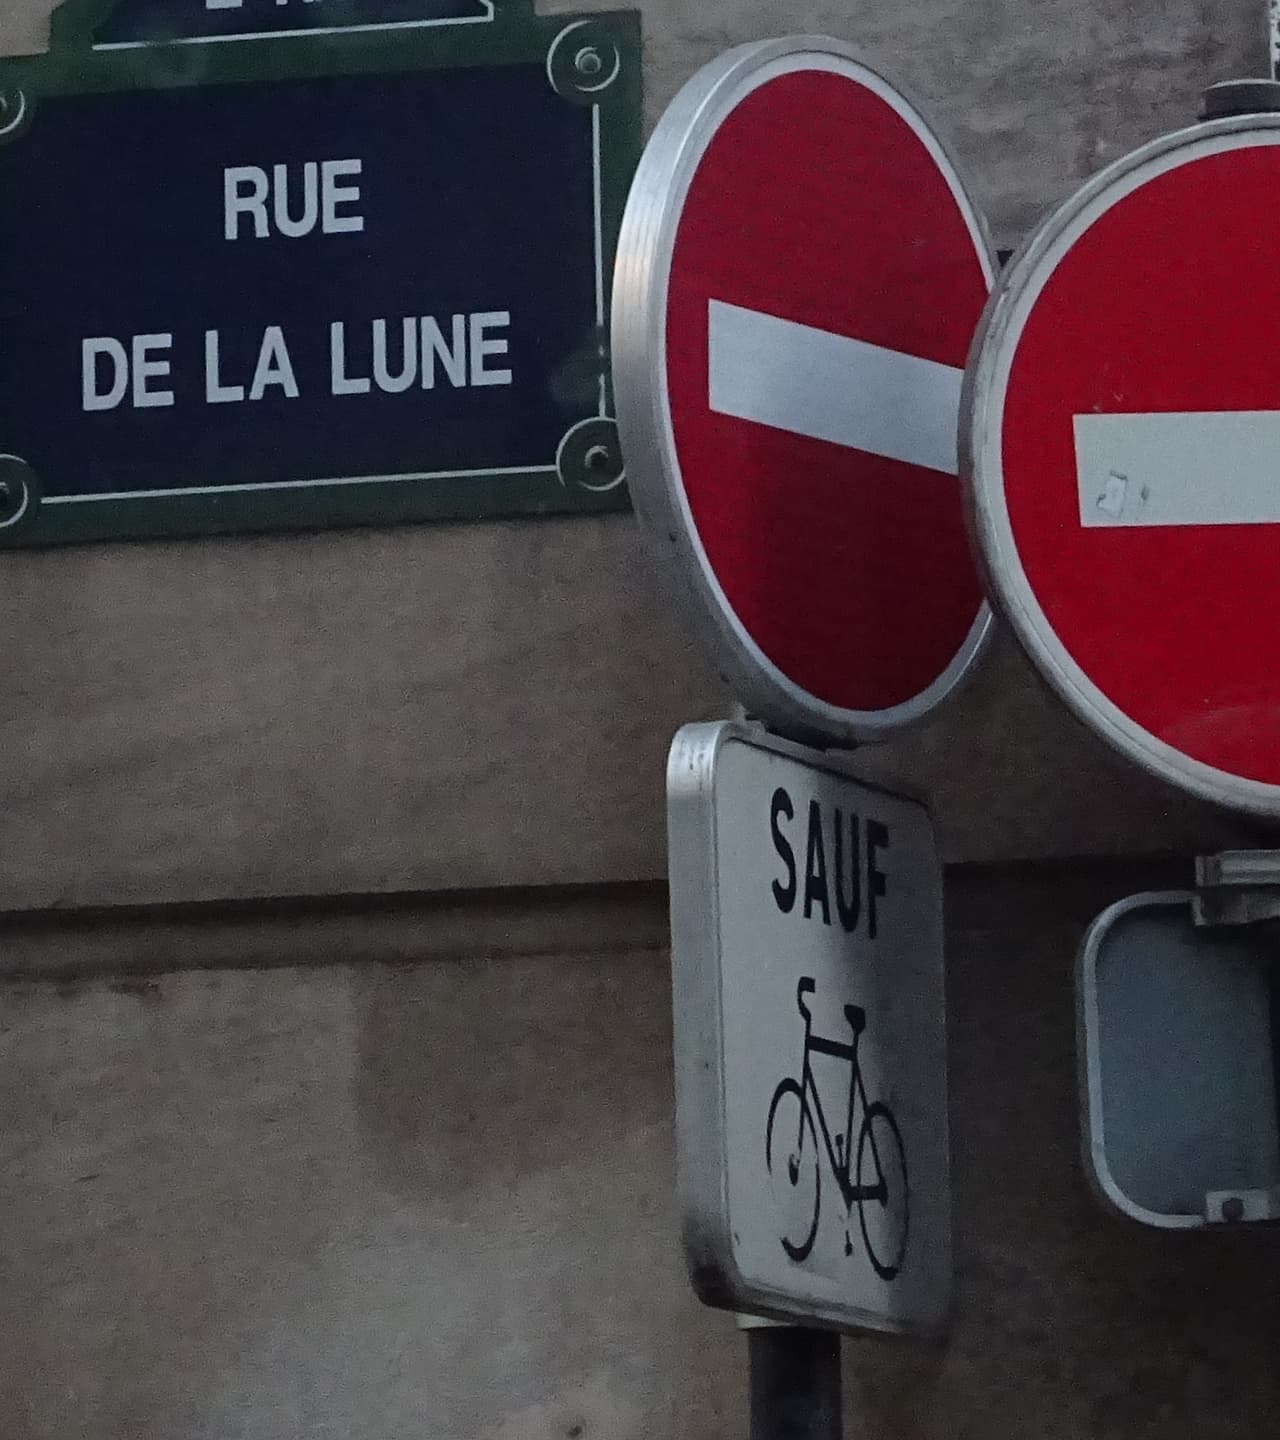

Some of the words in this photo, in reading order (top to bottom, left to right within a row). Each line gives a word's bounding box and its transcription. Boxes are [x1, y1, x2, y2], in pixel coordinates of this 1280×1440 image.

[223, 158, 365, 241] RUE
[80, 331, 175, 412] DE
[203, 325, 299, 404] LA
[329, 310, 513, 397] LUNE
[770, 787, 889, 940] SAUF
